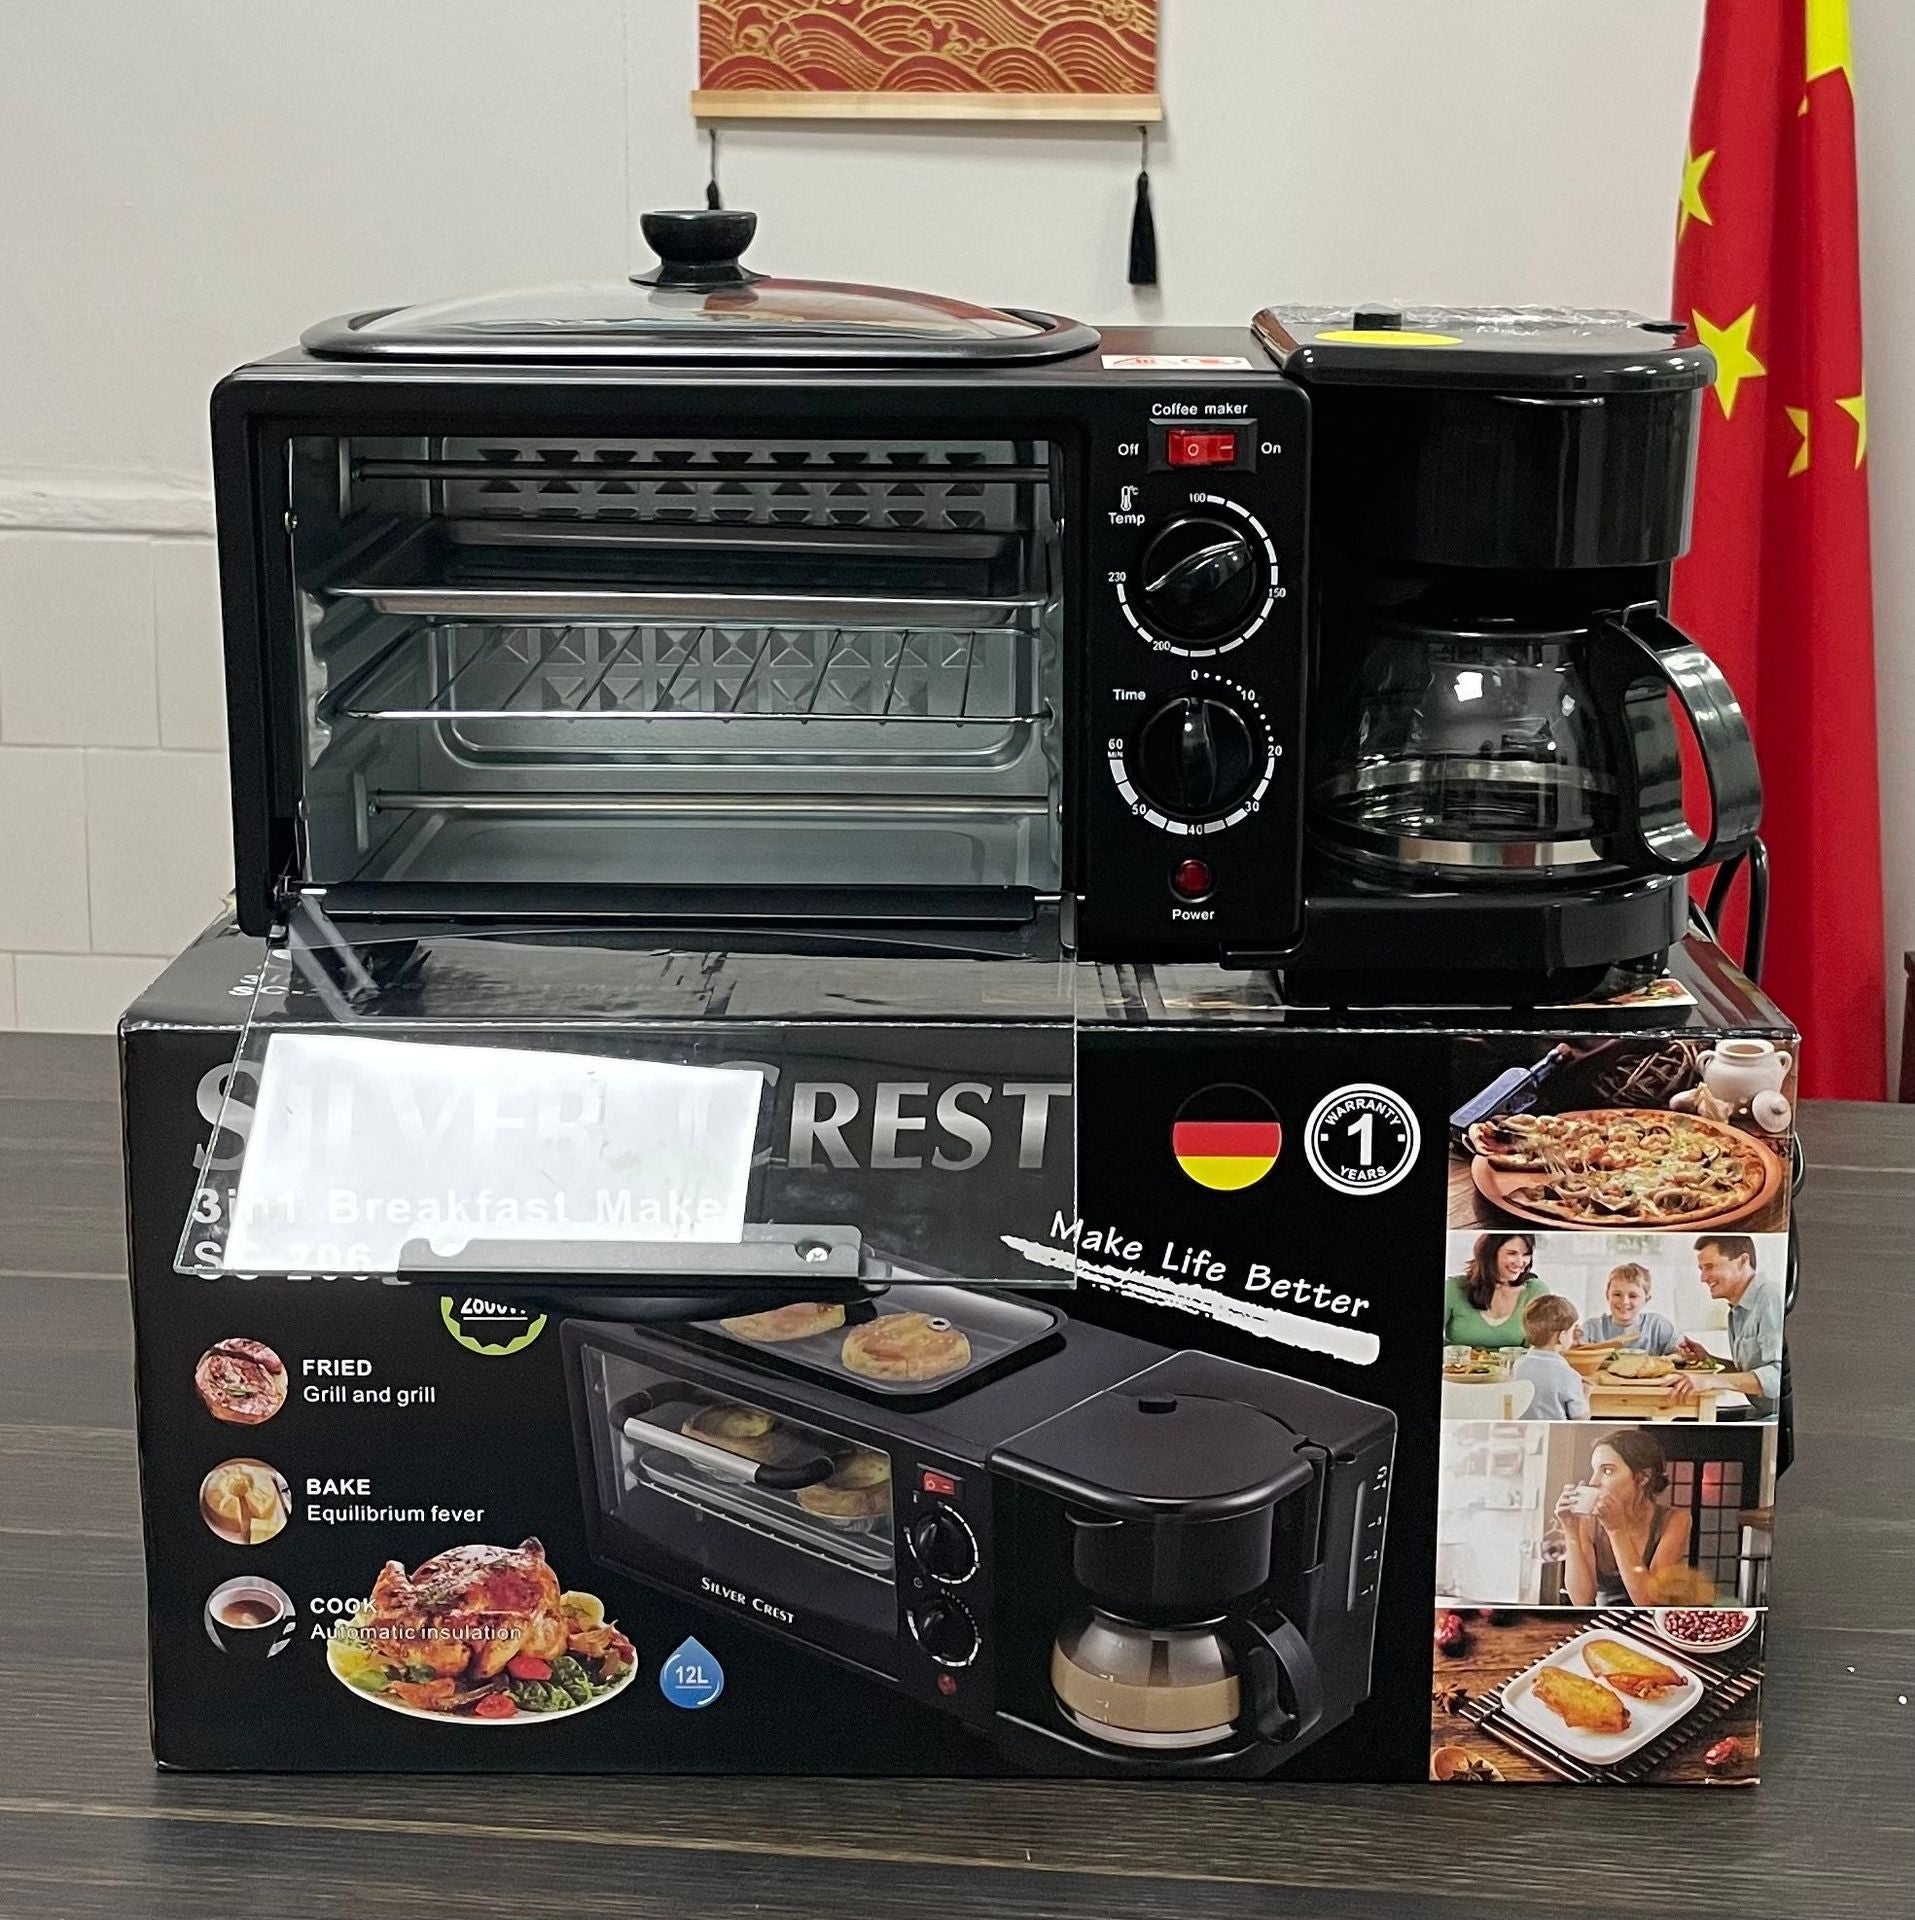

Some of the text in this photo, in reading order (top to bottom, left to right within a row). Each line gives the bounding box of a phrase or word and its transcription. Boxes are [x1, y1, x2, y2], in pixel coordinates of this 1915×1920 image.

[1151, 403, 1248, 415] Coffee maker
[1118, 444, 1140, 456] Off
[1261, 442, 1282, 455] On
[1189, 493, 1206, 503] 100
[1108, 512, 1146, 527] Temp
[1108, 572, 1127, 583] 230
[1268, 588, 1287, 598] 150
[1152, 641, 1171, 651] 200
[1190, 670, 1199, 680] 0
[1113, 689, 1147, 701] Time
[1241, 690, 1255, 701] 10
[1108, 738, 1123, 750] 60
[1268, 746, 1283, 757] 20
[1132, 804, 1147, 815] 50
[1245, 801, 1260, 812] 30
[1188, 824, 1203, 836] 40
[1172, 909, 1215, 921] Power
[1324, 1098, 1402, 1126] WARRANTY
[1347, 1113, 1373, 1166] 1
[1340, 1165, 1387, 1180] YEARS
[327, 1187, 570, 1225] Breakfast
[596, 1188, 738, 1225] Make
[1050, 1210, 1370, 1318] Make Life Better
[302, 1359, 373, 1376] FRIED
[303, 1385, 436, 1407] Grill and grill
[306, 1478, 371, 1495] BAKE
[307, 1505, 485, 1525] Equilibrium fever
[310, 1597, 377, 1614] COOK
[701, 1576, 795, 1624] SILVER CREST
[310, 1623, 522, 1641] Automatic insulation
[675, 1665, 709, 1684] 12L
